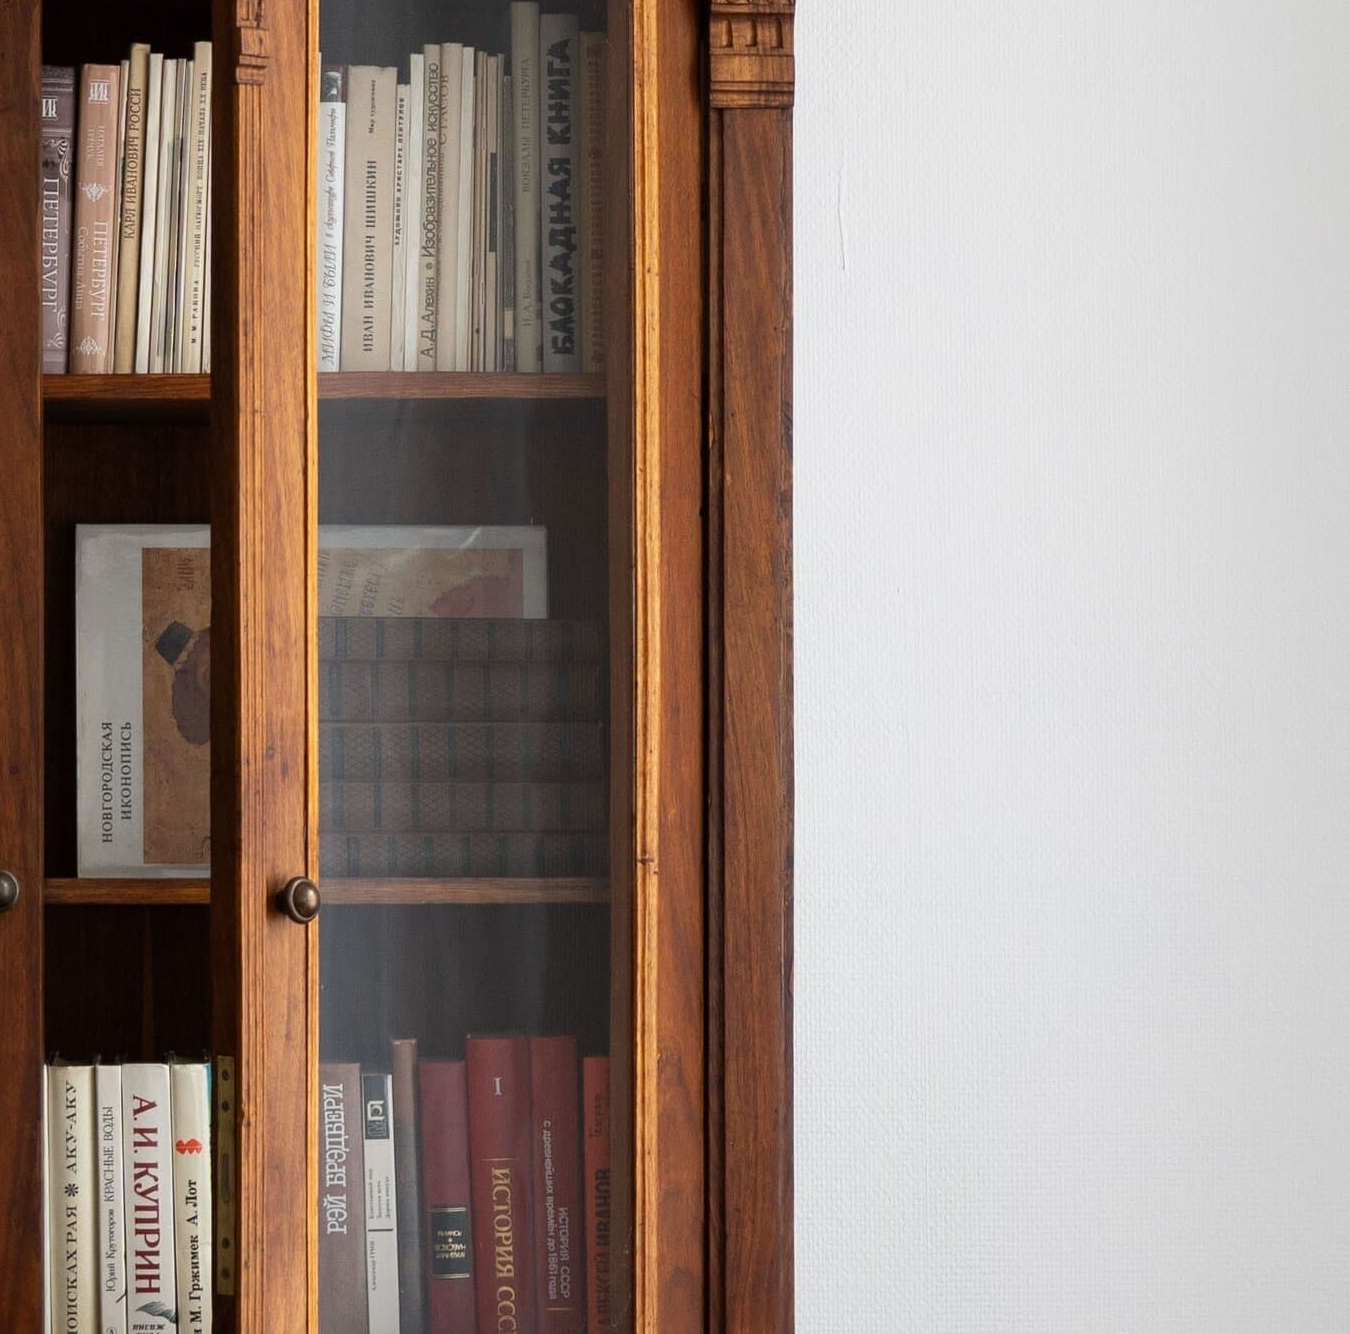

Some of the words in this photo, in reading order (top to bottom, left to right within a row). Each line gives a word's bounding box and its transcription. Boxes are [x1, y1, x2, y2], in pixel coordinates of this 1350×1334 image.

[127, 87, 142, 132] РОССИ
[424, 62, 442, 133] искусство
[520, 58, 531, 130] ПЕТЕРБУРГА
[546, 38, 573, 146] КНИГА
[397, 97, 406, 144] ЛЕНТУЛОВ
[124, 135, 140, 205] ИВАНОВИЧ
[521, 135, 531, 193] ВОКЗАЛЫ
[365, 160, 378, 229] ШИШКИН
[422, 137, 440, 259] Изобразительное
[41, 176, 61, 313] ПЕТЕРБУРГ
[122, 207, 137, 240] КАРЛ
[90, 220, 109, 322] ПЕТЕРБУРГ
[322, 243, 338, 290] БЫЛИ
[363, 235, 377, 310] ИВАНОВИЧ
[546, 156, 577, 356] БЛОКАДНАЯ
[322, 294, 336, 308] И
[320, 311, 335, 365] МИФЫ
[363, 315, 375, 353] ИВАН
[101, 722, 114, 844] НОВГОРОДСКАЯ
[120, 721, 132, 820] ИКОНОПИСЬ
[65, 1079, 78, 1175] АКУ-АКУ
[102, 1105, 115, 1143] ВОДЫ
[133, 1095, 158, 1121] А.
[322, 1082, 350, 1188] БРЭДБЕРИ
[543, 1119, 552, 1128] с
[133, 1127, 159, 1154] И.
[542, 1129, 556, 1195] древнейших
[102, 1145, 115, 1203] КРАСНЫЕ
[185, 1179, 199, 1209] Лот
[65, 1204, 78, 1244] РАЯ
[105, 1208, 118, 1259] Крутогоров
[133, 1161, 161, 1294] КУПРИН
[187, 1210, 199, 1227] А.
[323, 1193, 348, 1236] РЭЙ
[491, 1166, 516, 1278] ИСТОРИЯ
[558, 1206, 571, 1262] ИСТОРИЯ
[594, 1168, 611, 1247] ИВАНОВ
[186, 1234, 203, 1302] Гржимек
[547, 1237, 558, 1252] до
[105, 1262, 117, 1292] Юрий
[548, 1275, 559, 1300] года
[559, 1265, 572, 1299] СССР
[132, 1323, 166, 1331] жизни
[189, 1306, 203, 1324] М.
